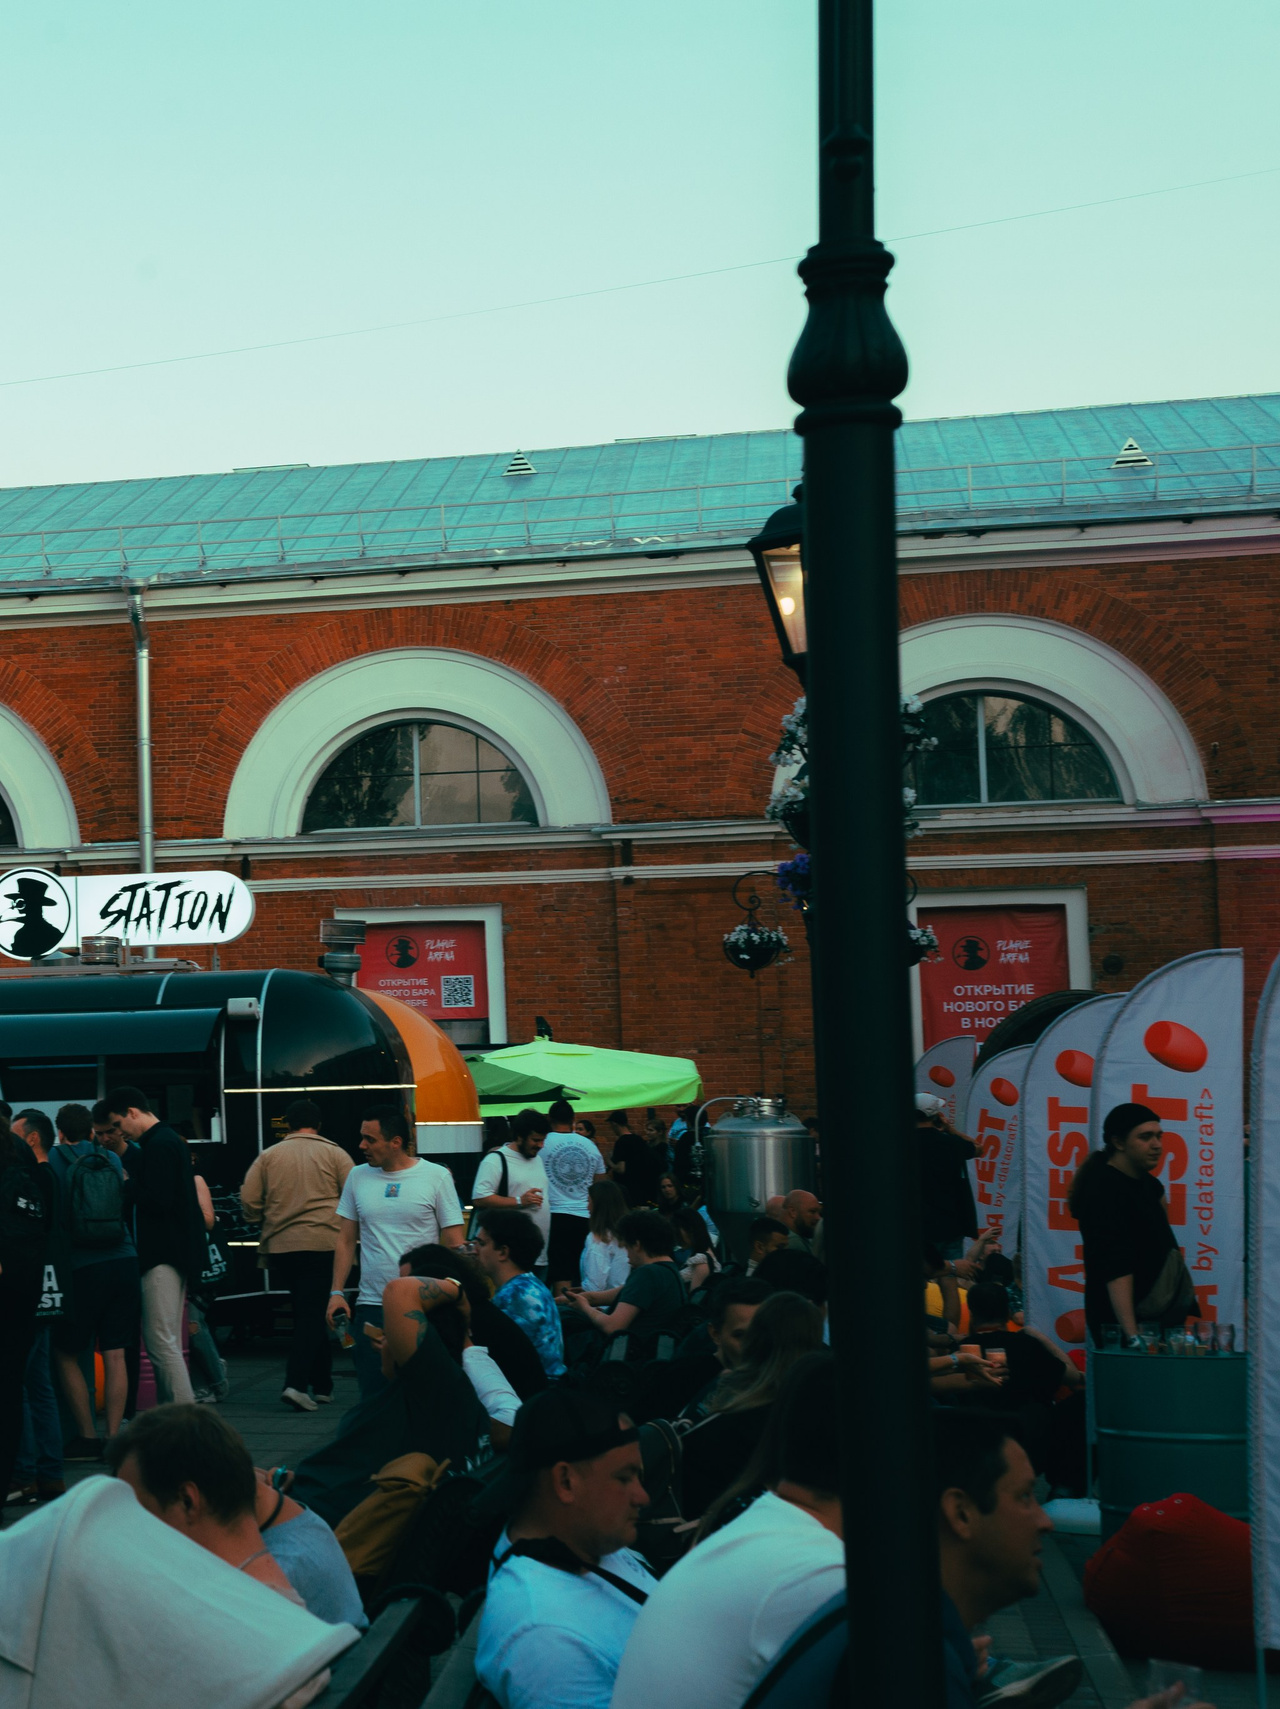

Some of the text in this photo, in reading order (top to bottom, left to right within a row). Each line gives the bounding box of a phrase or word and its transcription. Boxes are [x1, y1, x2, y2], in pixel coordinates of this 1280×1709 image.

[97, 874, 234, 939] STATION
[378, 978, 429, 987] ОТКРЫТИЕ
[378, 988, 436, 997] ОВОГО БАРА
[953, 984, 1035, 996] ОТКРЫТИЕ
[943, 1001, 1005, 1012] НОВОГО
[961, 1017, 971, 1028] В
[975, 1108, 1006, 1206] FEST
[1047, 1096, 1089, 1231] FEST
[1192, 1242, 1219, 1271] by
